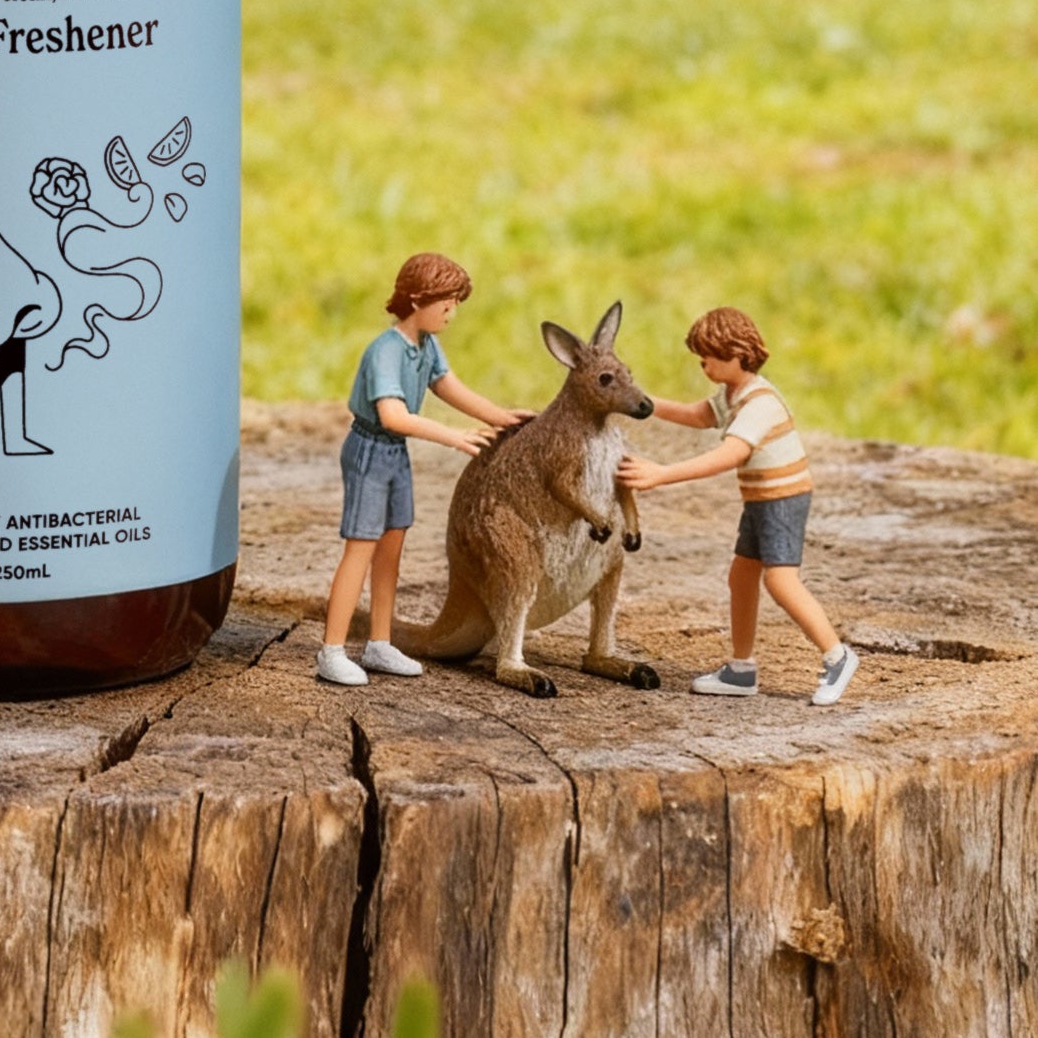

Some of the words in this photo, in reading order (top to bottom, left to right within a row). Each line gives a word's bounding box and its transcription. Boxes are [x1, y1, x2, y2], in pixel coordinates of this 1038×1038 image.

[6, 507, 140, 529] ANTIBACTERIAL
[19, 532, 109, 551] ESSENTIAL
[115, 527, 150, 543] OILS
